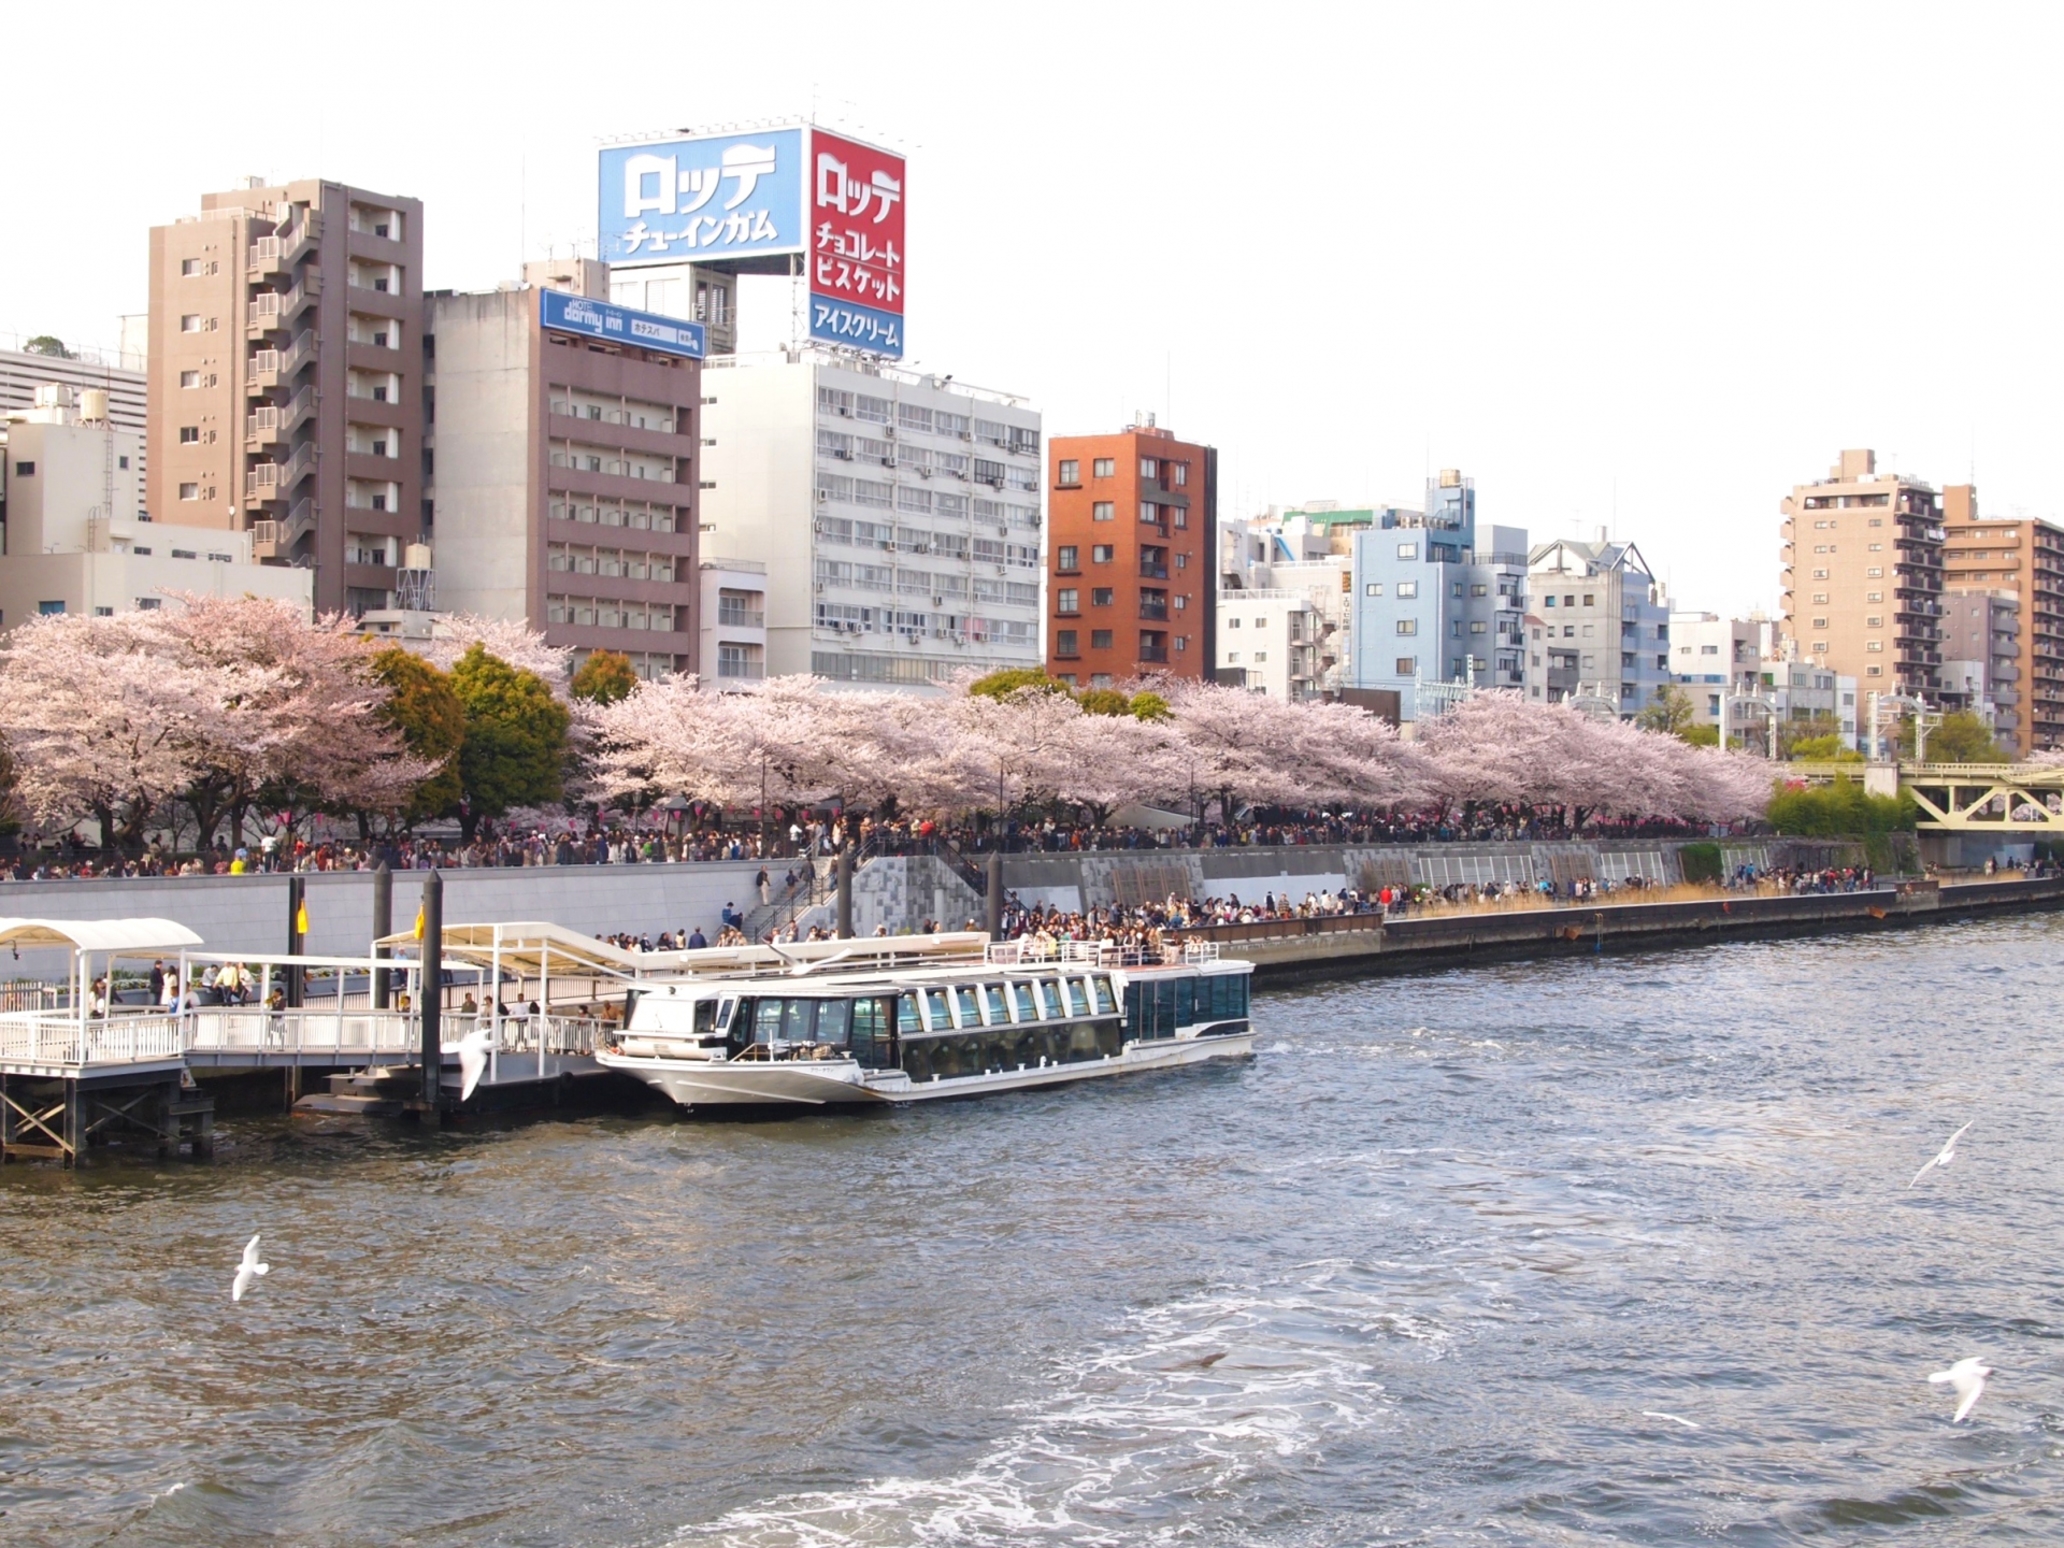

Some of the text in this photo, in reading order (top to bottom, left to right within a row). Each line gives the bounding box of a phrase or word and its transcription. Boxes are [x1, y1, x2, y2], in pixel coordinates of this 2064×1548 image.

[624, 143, 777, 219] ロッテ
[816, 152, 900, 224] ロッテ
[622, 209, 779, 255] チューインガム
[815, 220, 900, 268] チョコレート
[816, 255, 900, 302] ビスケット
[564, 301, 623, 334] dormy inn
[572, 299, 594, 311] HOTEL
[814, 303, 900, 347] アイスクリーム
[634, 322, 660, 337] ホテスパ
